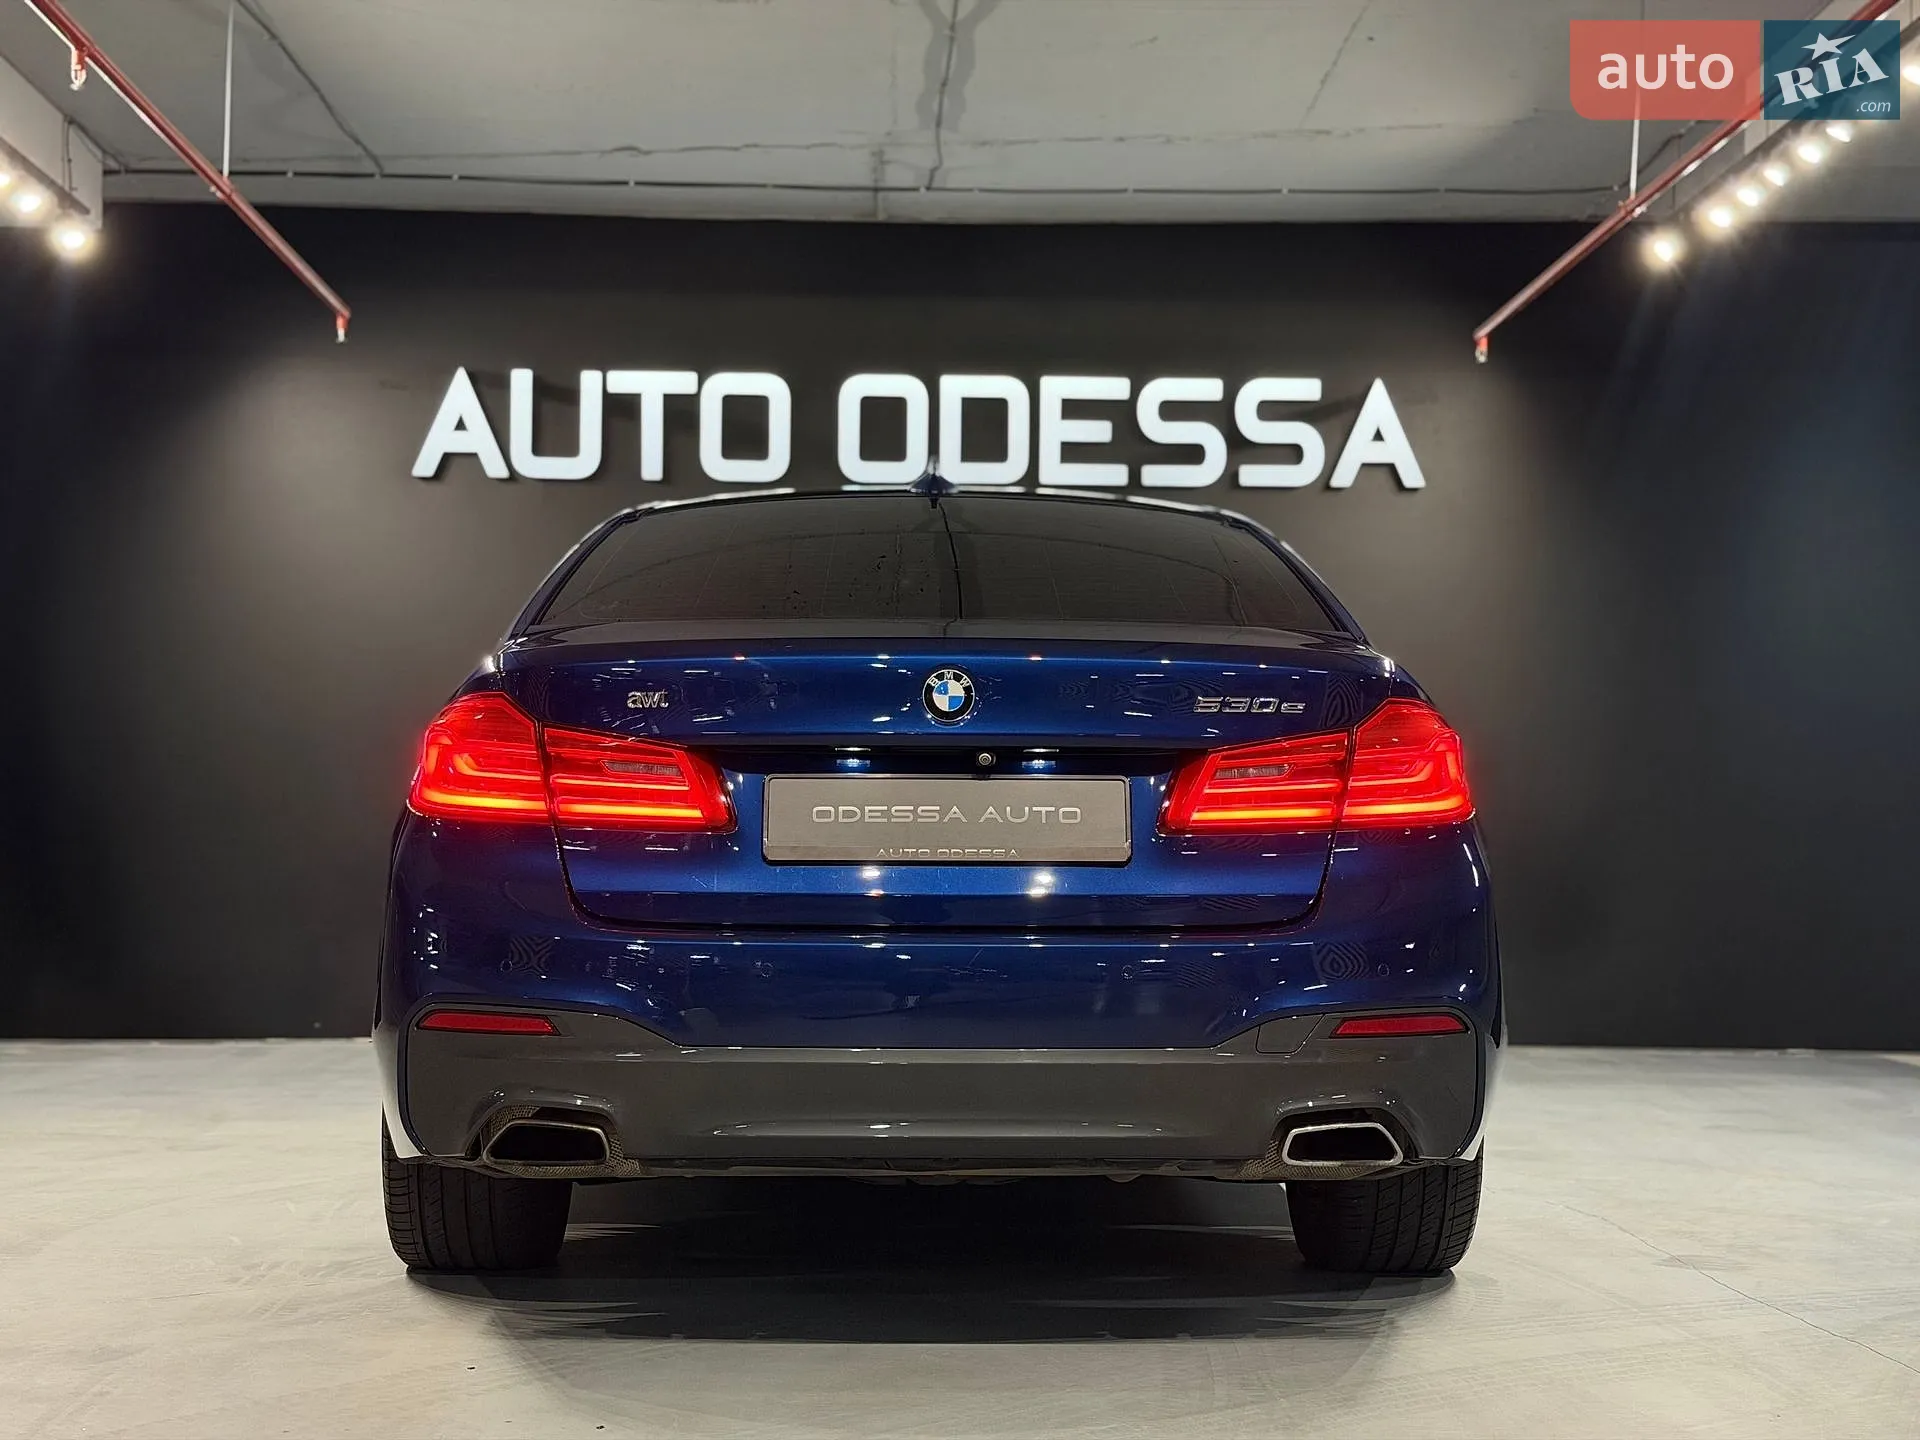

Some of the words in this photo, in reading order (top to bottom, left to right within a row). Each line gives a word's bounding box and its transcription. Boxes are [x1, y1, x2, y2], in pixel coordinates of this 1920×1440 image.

[411, 366, 792, 483] AUTO
[837, 373, 1426, 488] ODESSA
[928, 671, 970, 688] BMW
[1193, 696, 1306, 713] 530e
[812, 806, 967, 823] ODESSA
[978, 806, 1081, 823] AUTO
[876, 848, 930, 858] AUTO
[937, 848, 1020, 858] ODESSA
